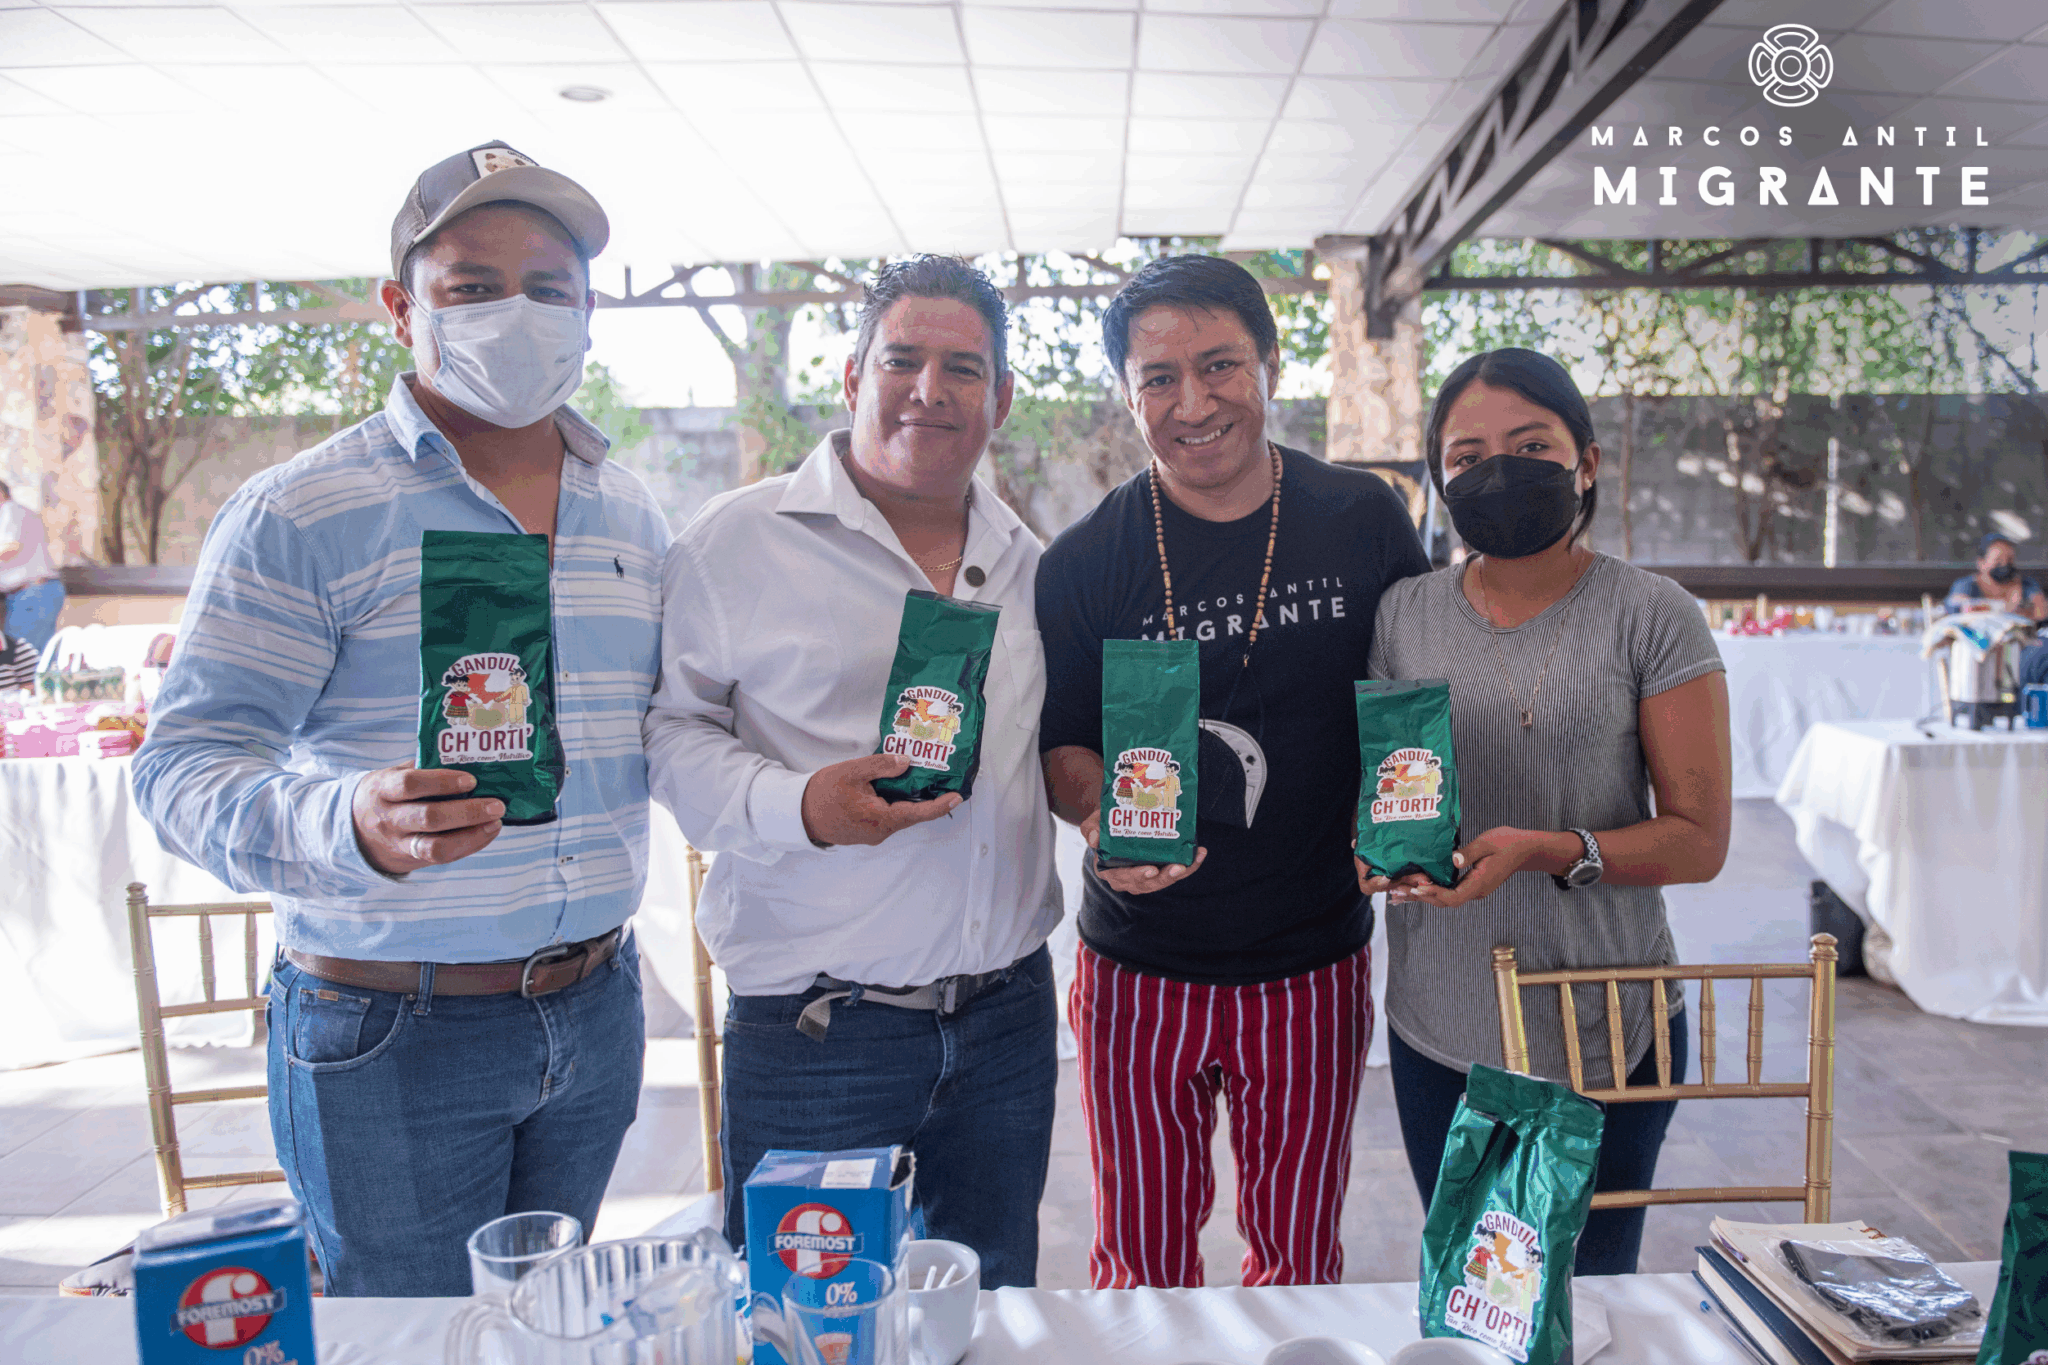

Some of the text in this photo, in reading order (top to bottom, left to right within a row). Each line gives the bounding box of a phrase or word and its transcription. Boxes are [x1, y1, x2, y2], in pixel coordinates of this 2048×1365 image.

[1142, 577, 1343, 626] MARCOS ANTIL
[451, 656, 517, 677] GANDUL
[906, 688, 956, 706] GANDUL
[441, 727, 531, 753] CH'ORTI'
[885, 736, 953, 762] CH'ORTI'
[1122, 750, 1171, 766] GANDUL
[1384, 750, 1431, 768] GANDUL
[1112, 809, 1180, 829] CH'ORTI'
[774, 1234, 856, 1251] FOREMOST
[1485, 1214, 1536, 1251] GANDUL
[825, 1281, 858, 1306] 0%
[177, 1294, 277, 1326] FOREMOST
